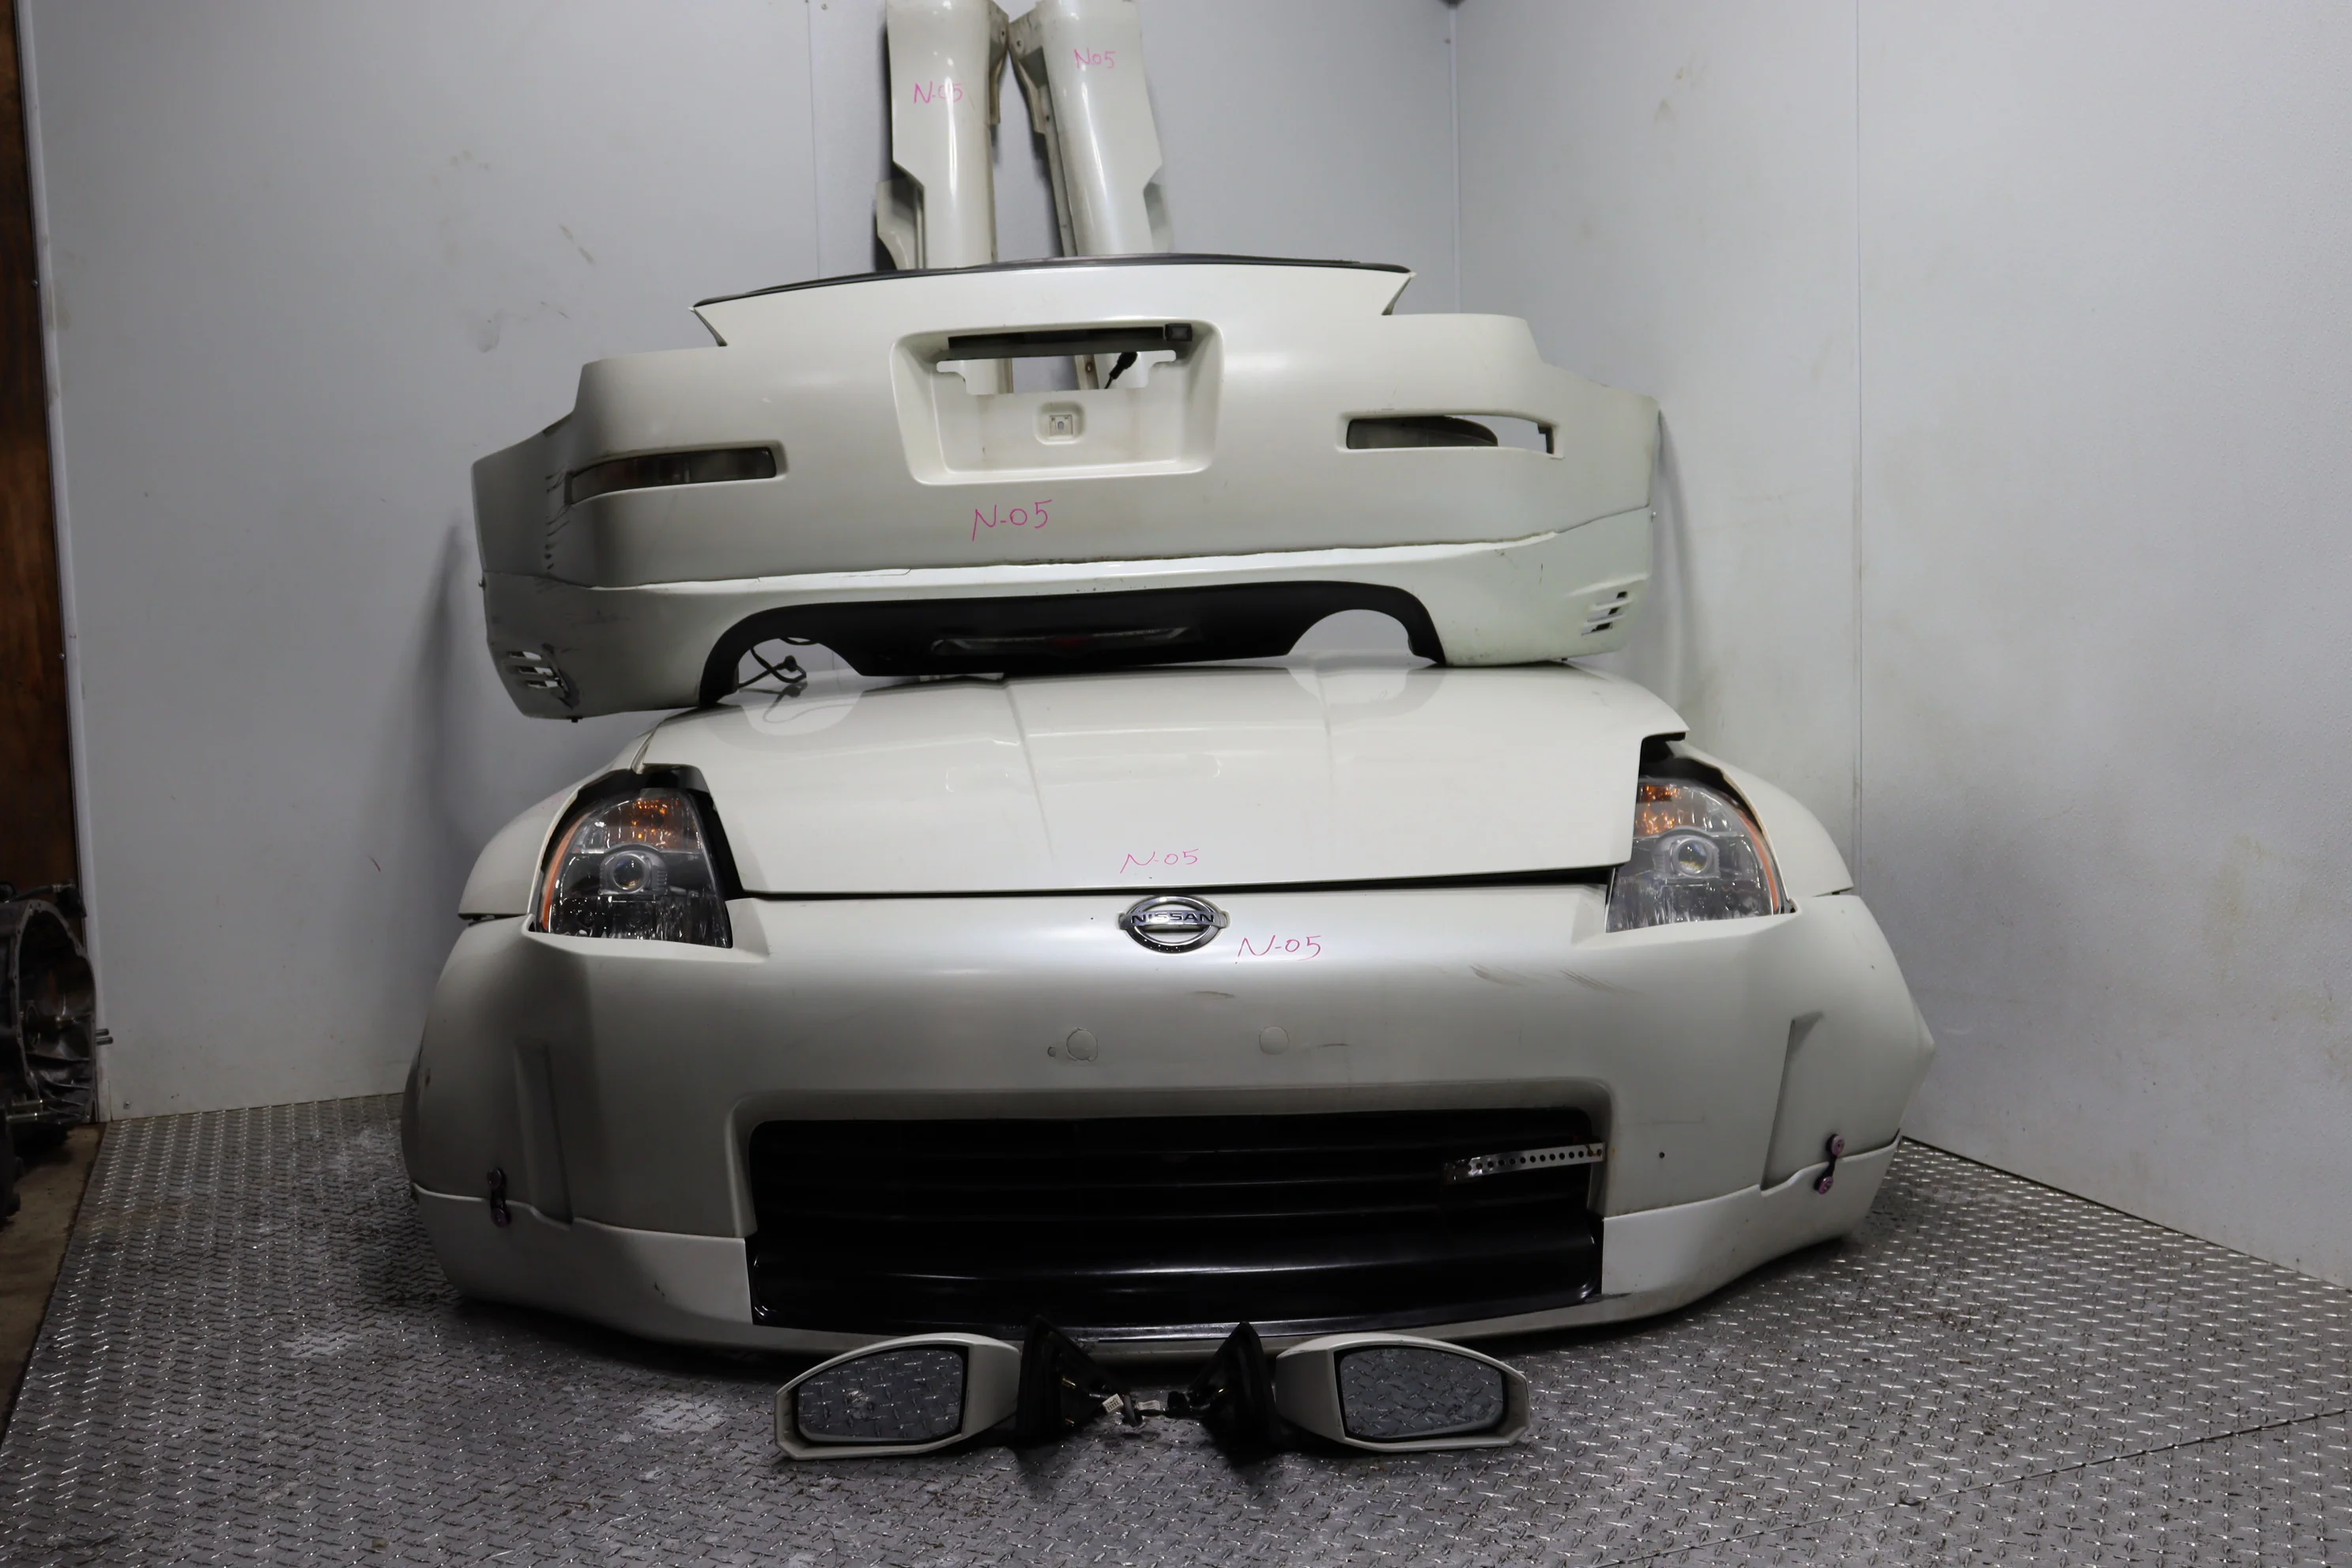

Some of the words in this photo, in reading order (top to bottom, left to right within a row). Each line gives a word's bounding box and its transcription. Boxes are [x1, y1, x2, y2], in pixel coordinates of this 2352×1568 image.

[972, 499, 1053, 541] N-05
[1120, 848, 1199, 873] N-05
[1131, 913, 1214, 924] NISSAN
[1237, 934, 1321, 961] N-05
